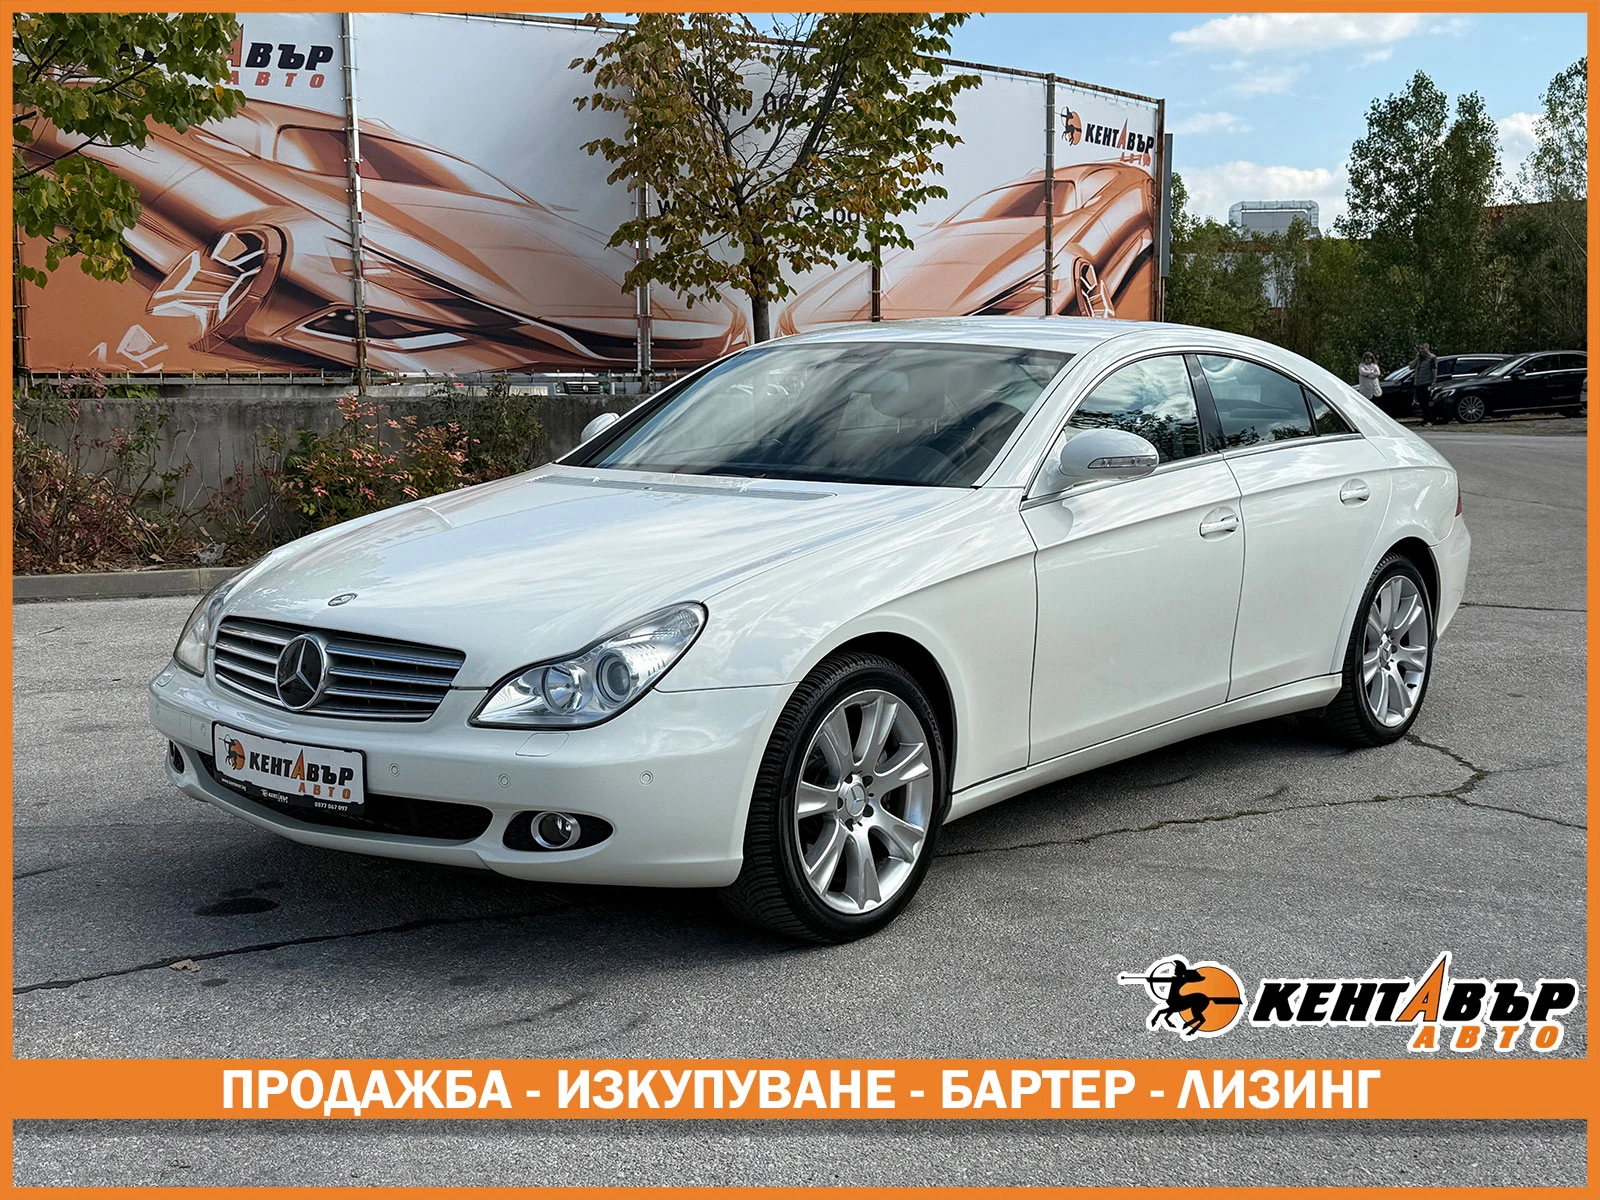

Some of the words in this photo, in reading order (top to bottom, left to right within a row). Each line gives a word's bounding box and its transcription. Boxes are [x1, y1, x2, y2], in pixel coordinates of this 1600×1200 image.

[1085, 118, 1155, 153] КЕНТАВЪР
[249, 749, 354, 786] КЕНТАВЪР
[298, 782, 351, 800] АВТО
